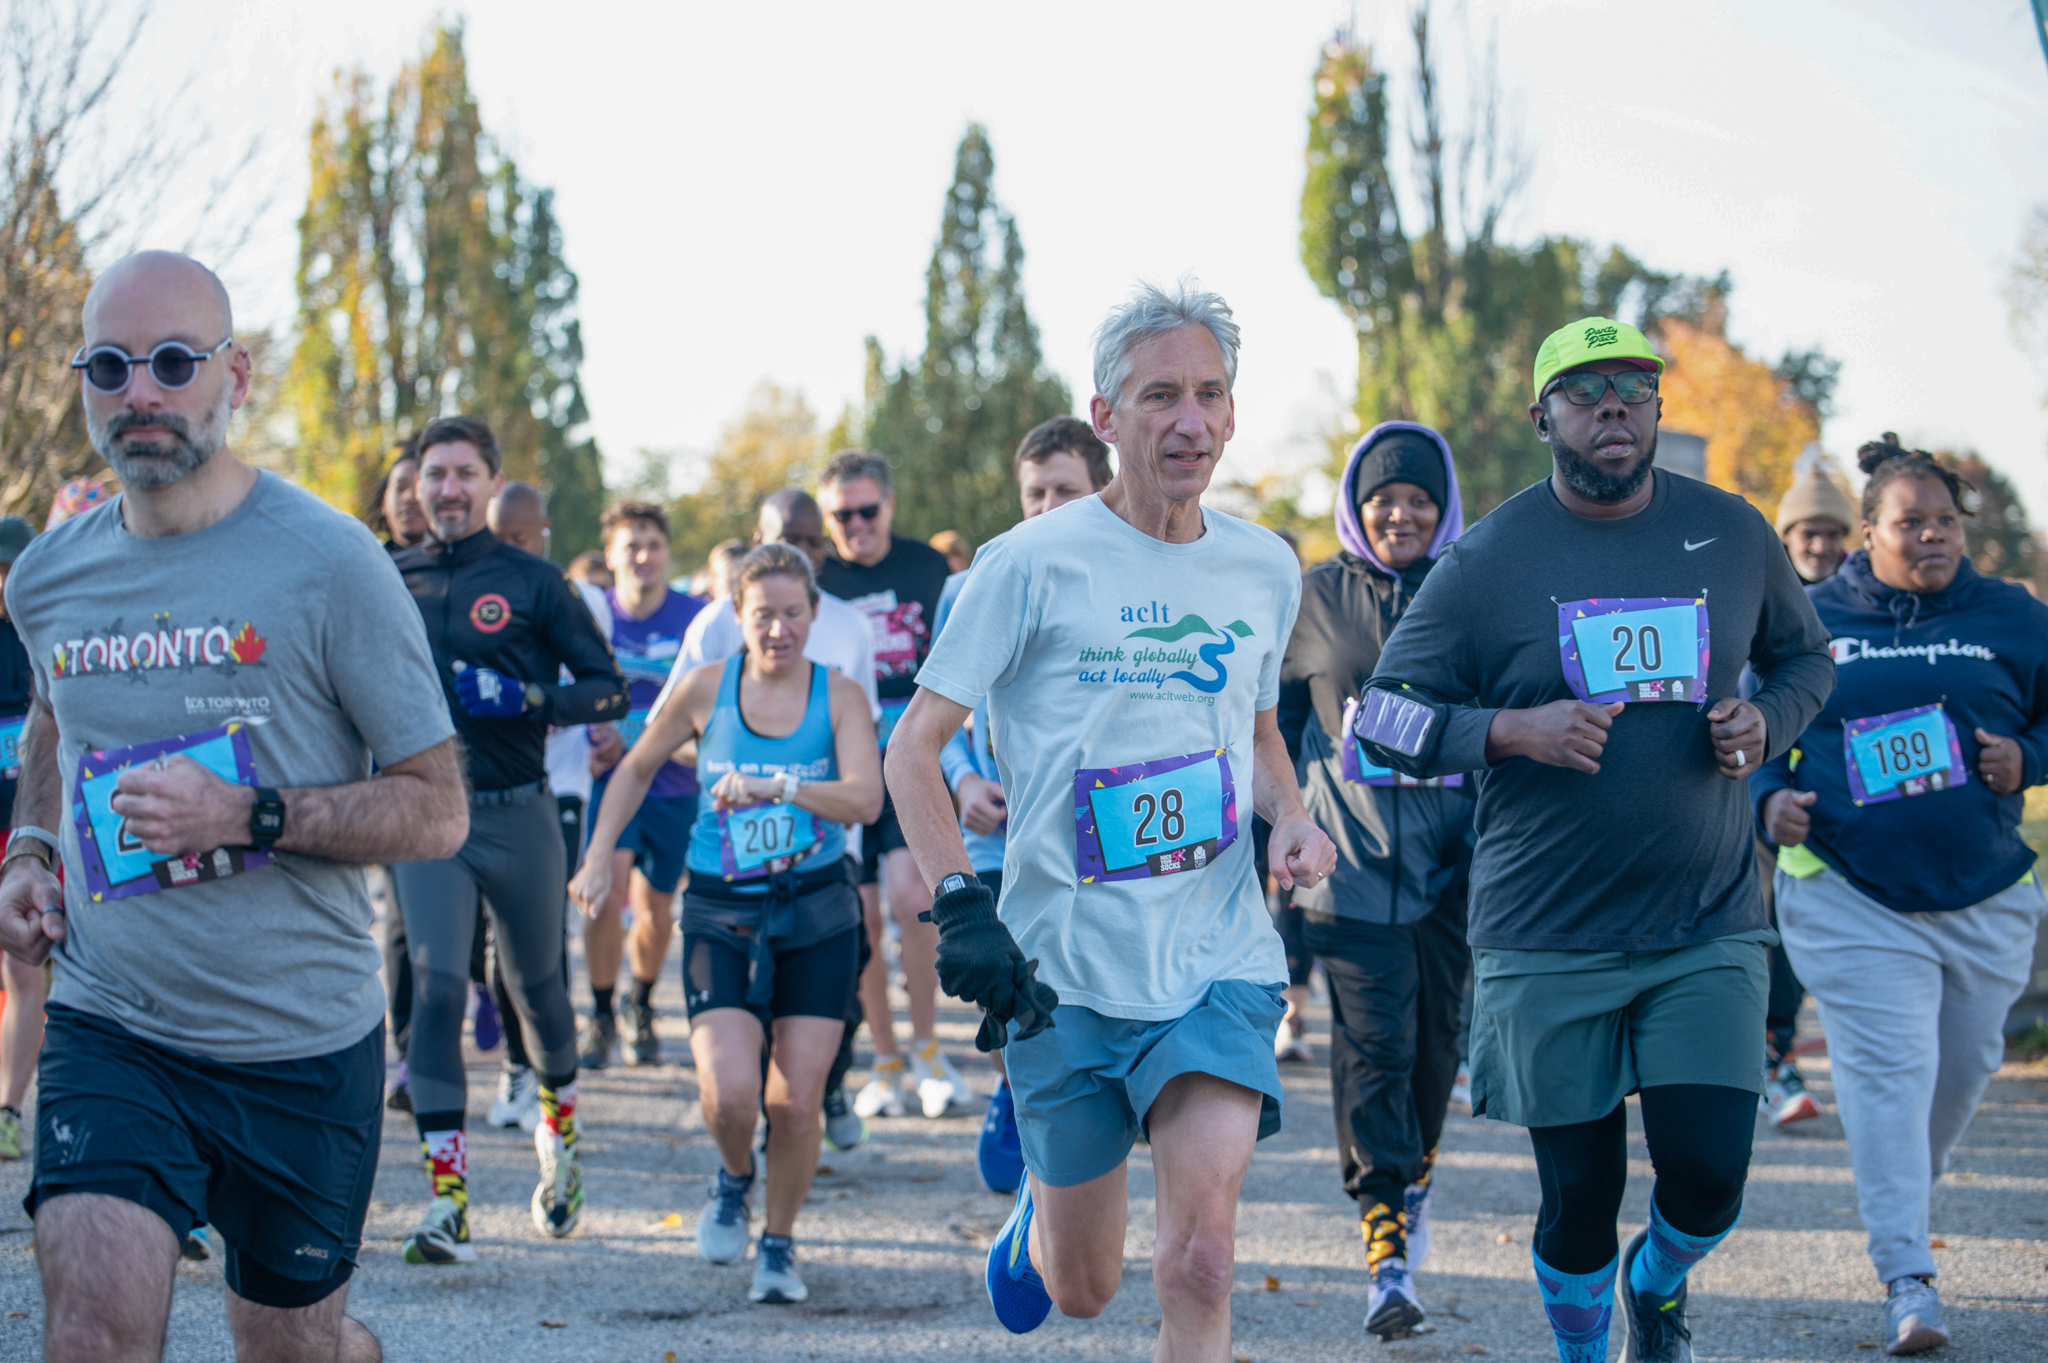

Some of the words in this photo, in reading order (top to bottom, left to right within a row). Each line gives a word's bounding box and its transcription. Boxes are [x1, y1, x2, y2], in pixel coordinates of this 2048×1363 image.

[1584, 326, 1618, 340] Party
[1587, 335, 1618, 348] Pace
[1120, 600, 1171, 624] aclt
[65, 626, 231, 676] TORONTO
[1079, 646, 1126, 663] think
[1133, 646, 1199, 671] globally
[1611, 624, 1663, 673] 20
[1829, 637, 1996, 665] Champion
[1078, 669, 1107, 683] act
[1113, 667, 1167, 689] locally
[1130, 690, 1215, 707] www.acltweb.org
[1871, 730, 1932, 777] 189
[1132, 787, 1186, 848] 28
[744, 816, 796, 854] 207
[1160, 861, 1181, 872] SOCKS
[1172, 848, 1186, 863] 5K
